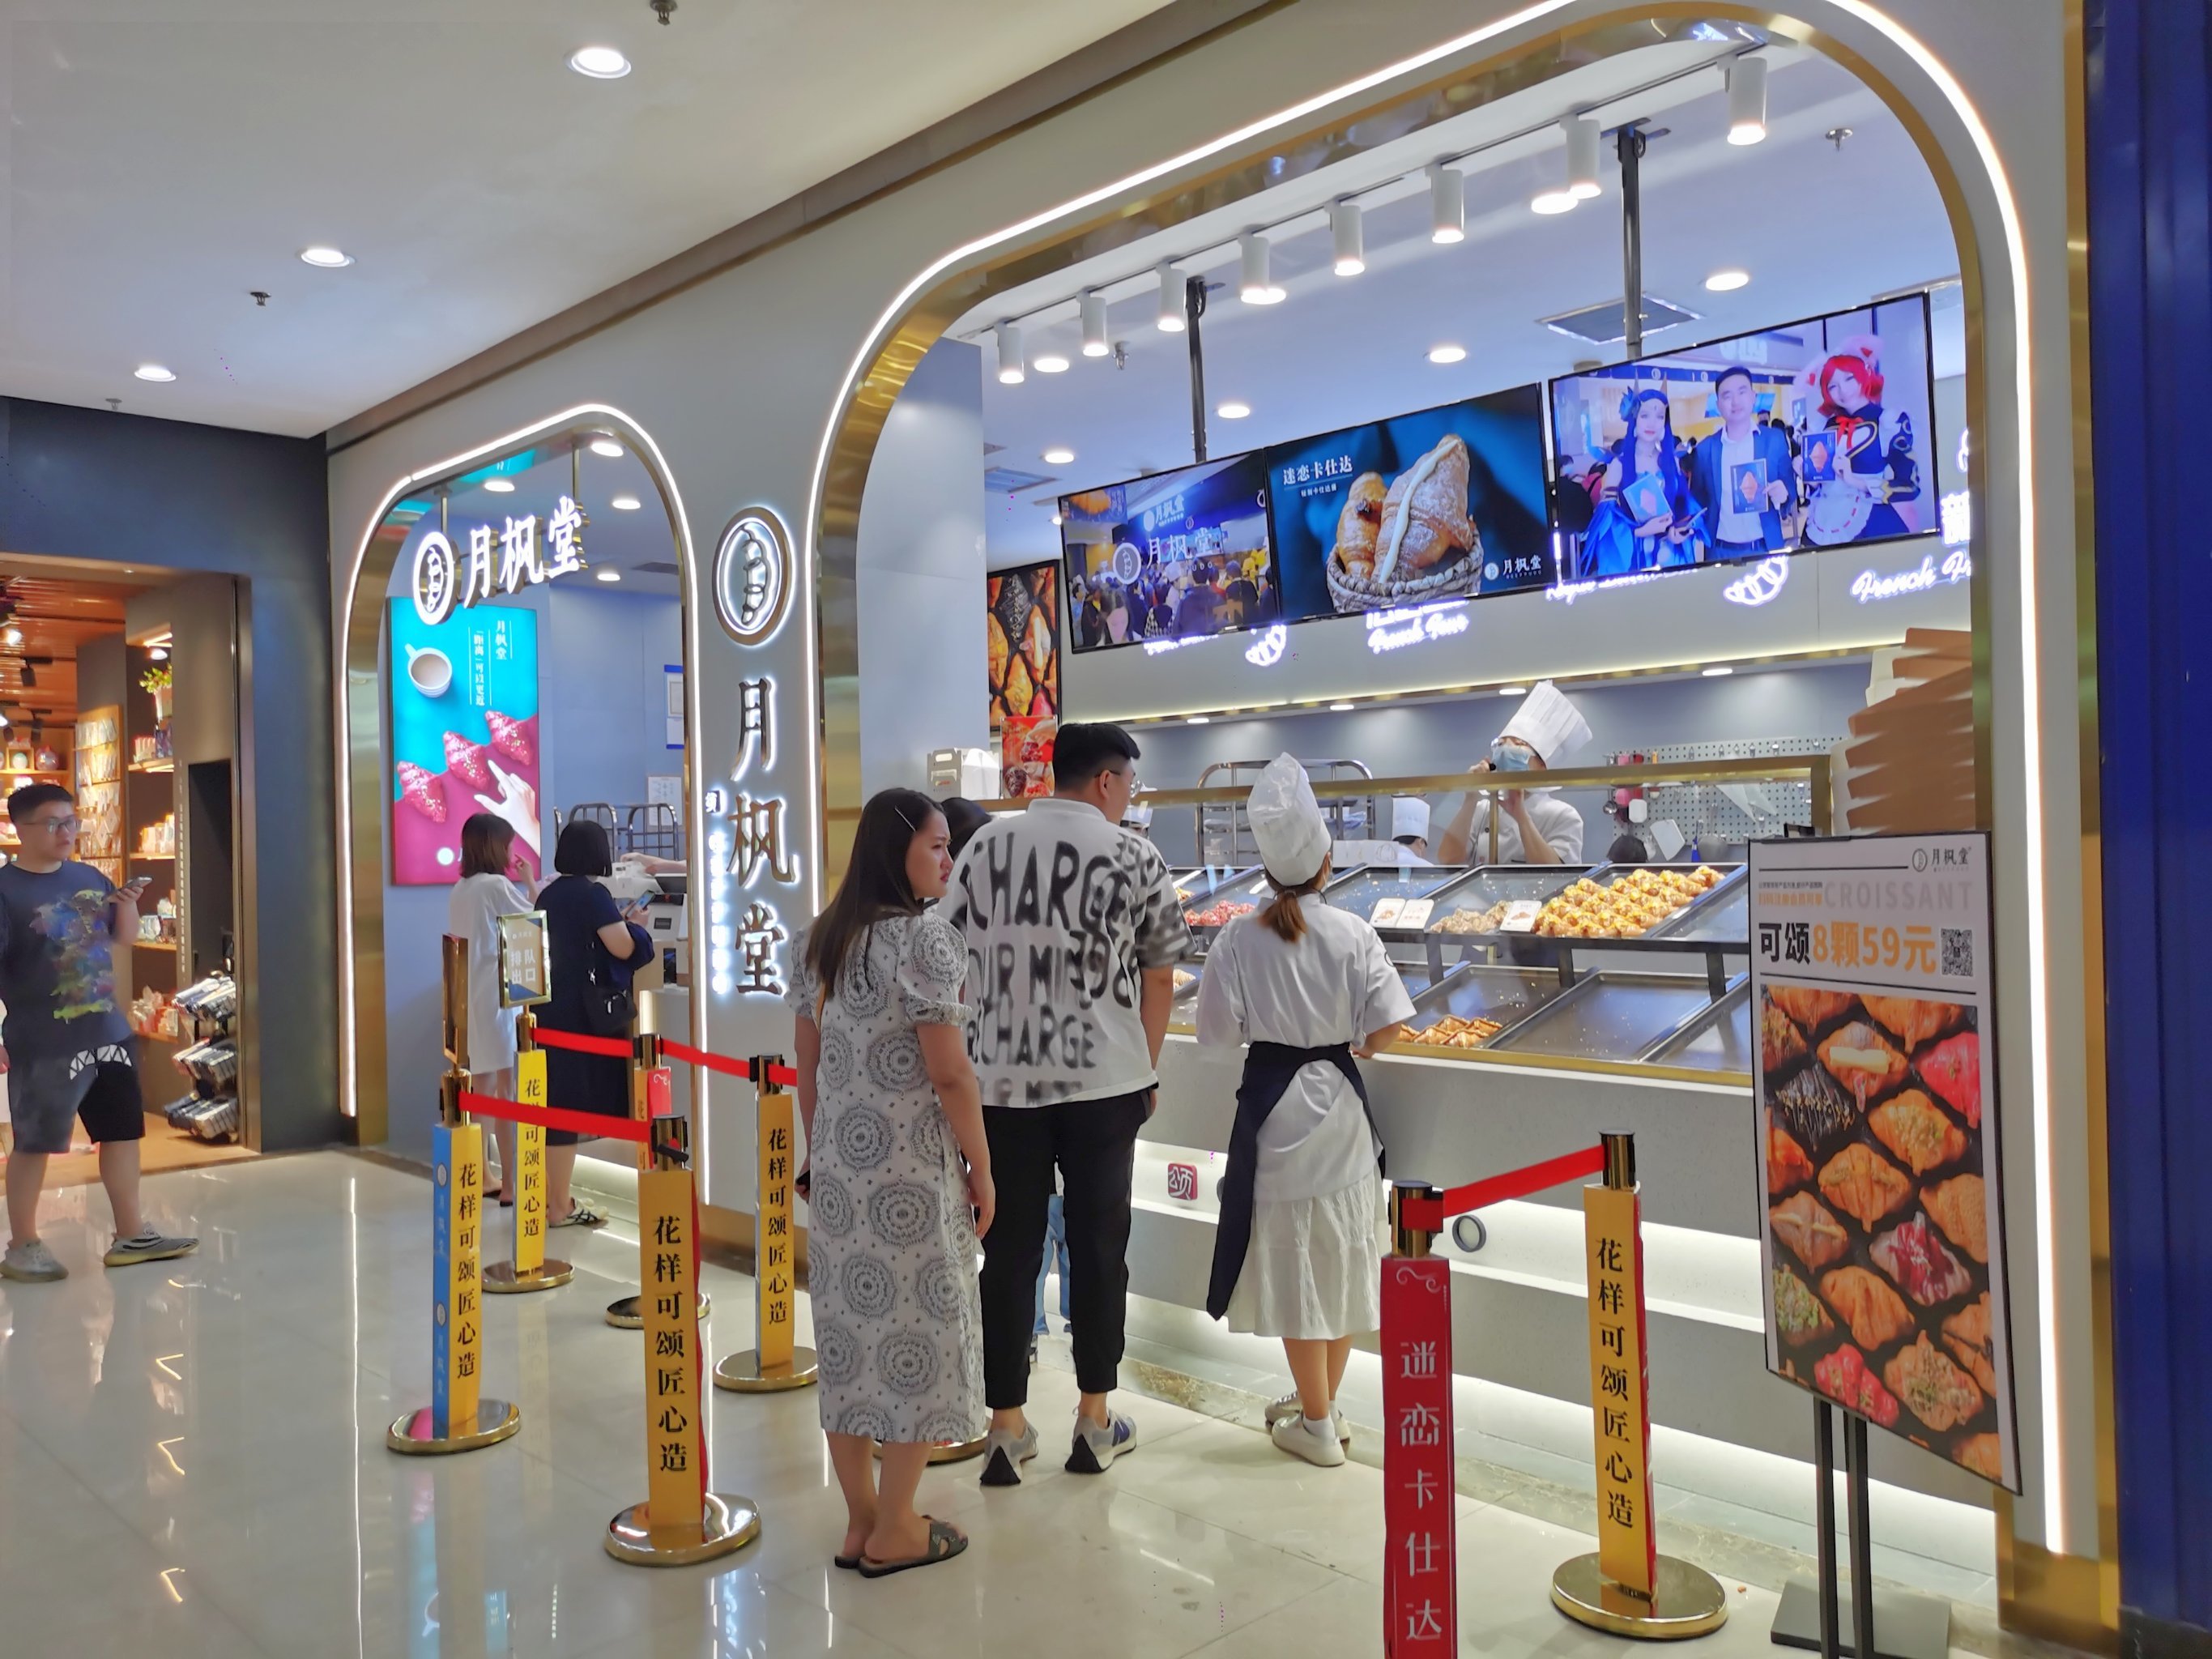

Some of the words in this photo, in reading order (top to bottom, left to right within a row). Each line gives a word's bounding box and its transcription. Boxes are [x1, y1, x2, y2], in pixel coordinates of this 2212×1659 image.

[1283, 454, 1353, 486] 迷恋卡仕达
[464, 495, 582, 608] 月枫堂
[1147, 527, 1212, 569] 月枫堂
[1502, 554, 1541, 576] 月枫堂
[496, 620, 508, 660] 月枫堂
[727, 677, 797, 995] 月枫堂
[1932, 847, 1969, 866] 月枫堂
[1824, 881, 1973, 911] CROISSANT
[511, 968, 536, 985] 出口
[1758, 921, 1937, 975] 可颂8颗59元
[523, 1078, 541, 1238] 花可颂匠心造
[766, 1127, 790, 1325] 花样可颂匠心造
[458, 1163, 477, 1379] 花样可颂匠心造
[654, 1215, 688, 1473] 花样可颂匠心造
[1596, 1237, 1634, 1529] 花样可颂匠心造
[1399, 1340, 1442, 1641] 迷恋卡仕达
